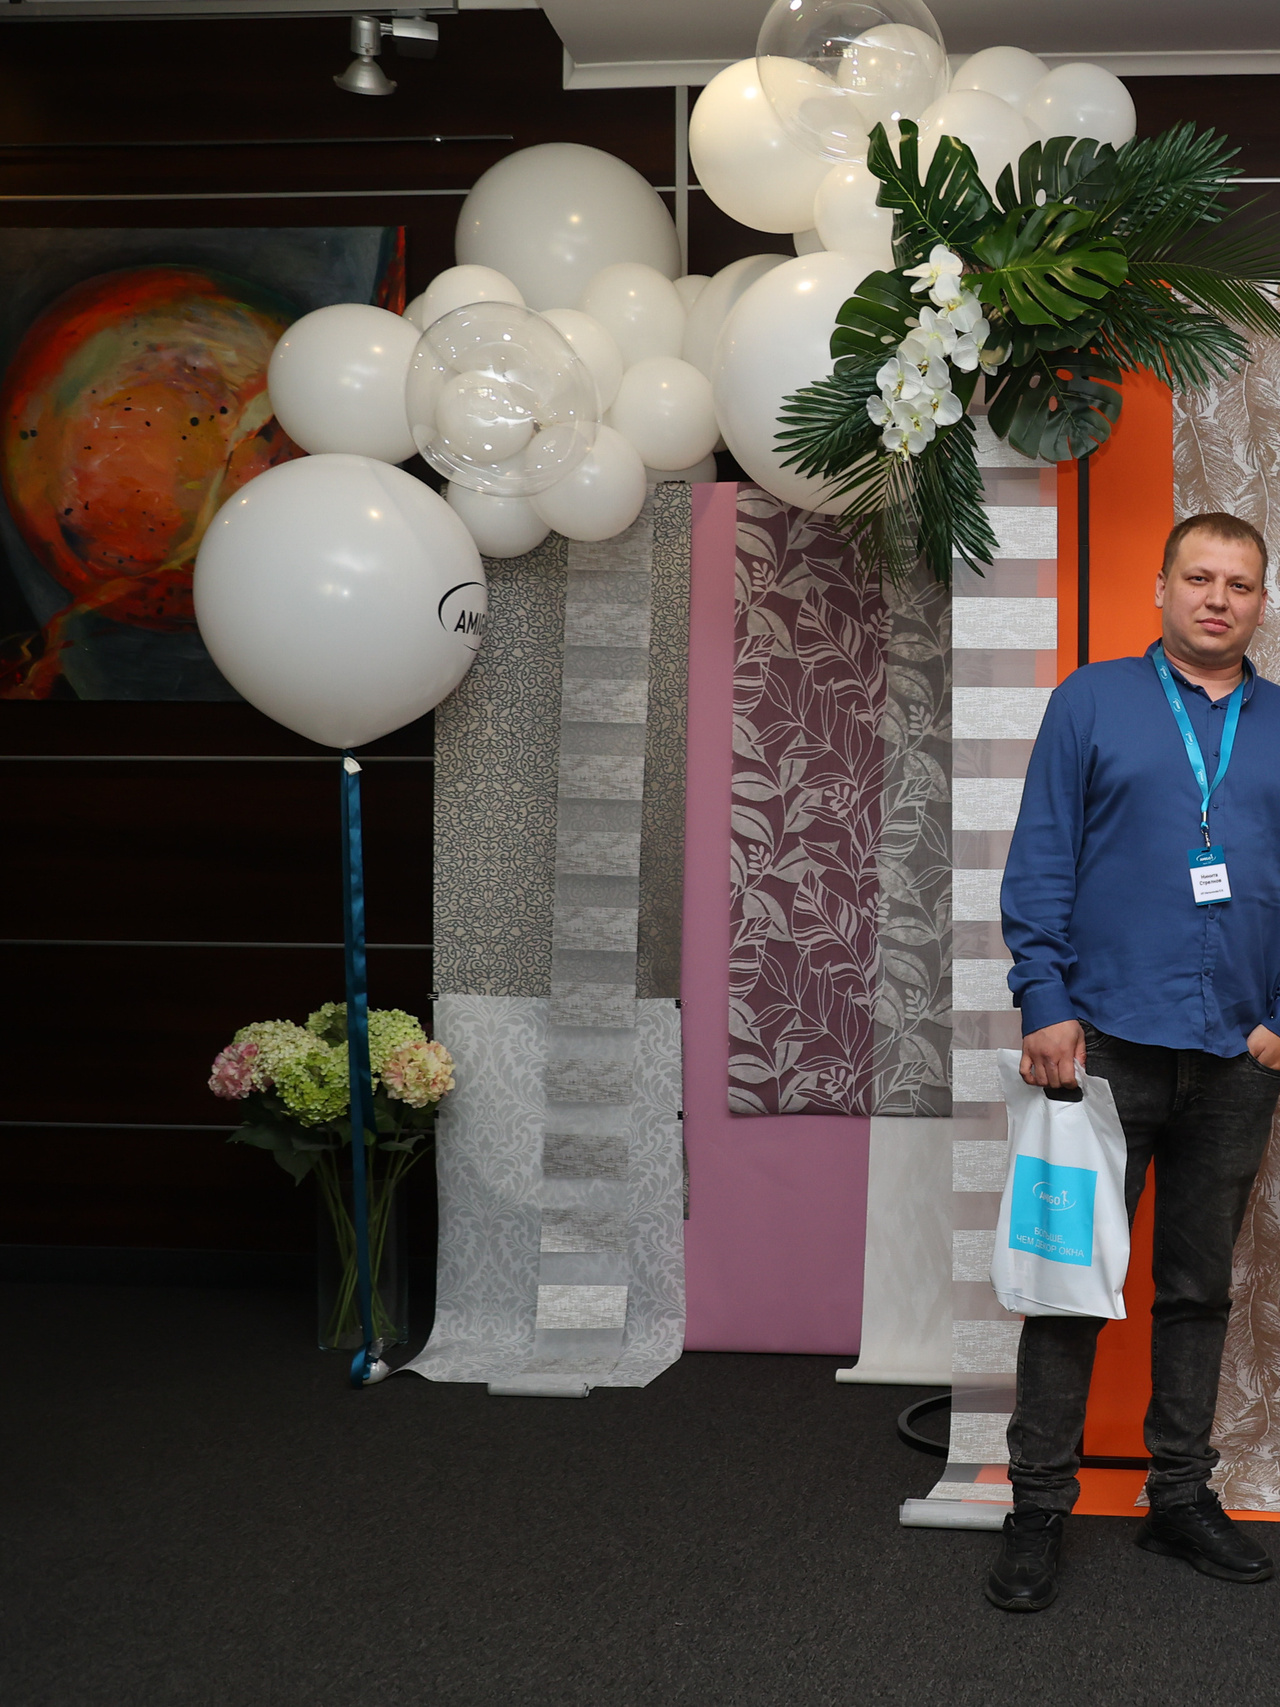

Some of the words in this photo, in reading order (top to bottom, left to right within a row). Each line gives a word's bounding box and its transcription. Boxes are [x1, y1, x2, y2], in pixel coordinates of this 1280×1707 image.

[1039, 1191, 1061, 1206] AMIGO
[1016, 1234, 1034, 1245] ЧЕМ
[1035, 1239, 1057, 1253] ДЕКОР
[1058, 1246, 1085, 1258] ОКНА
